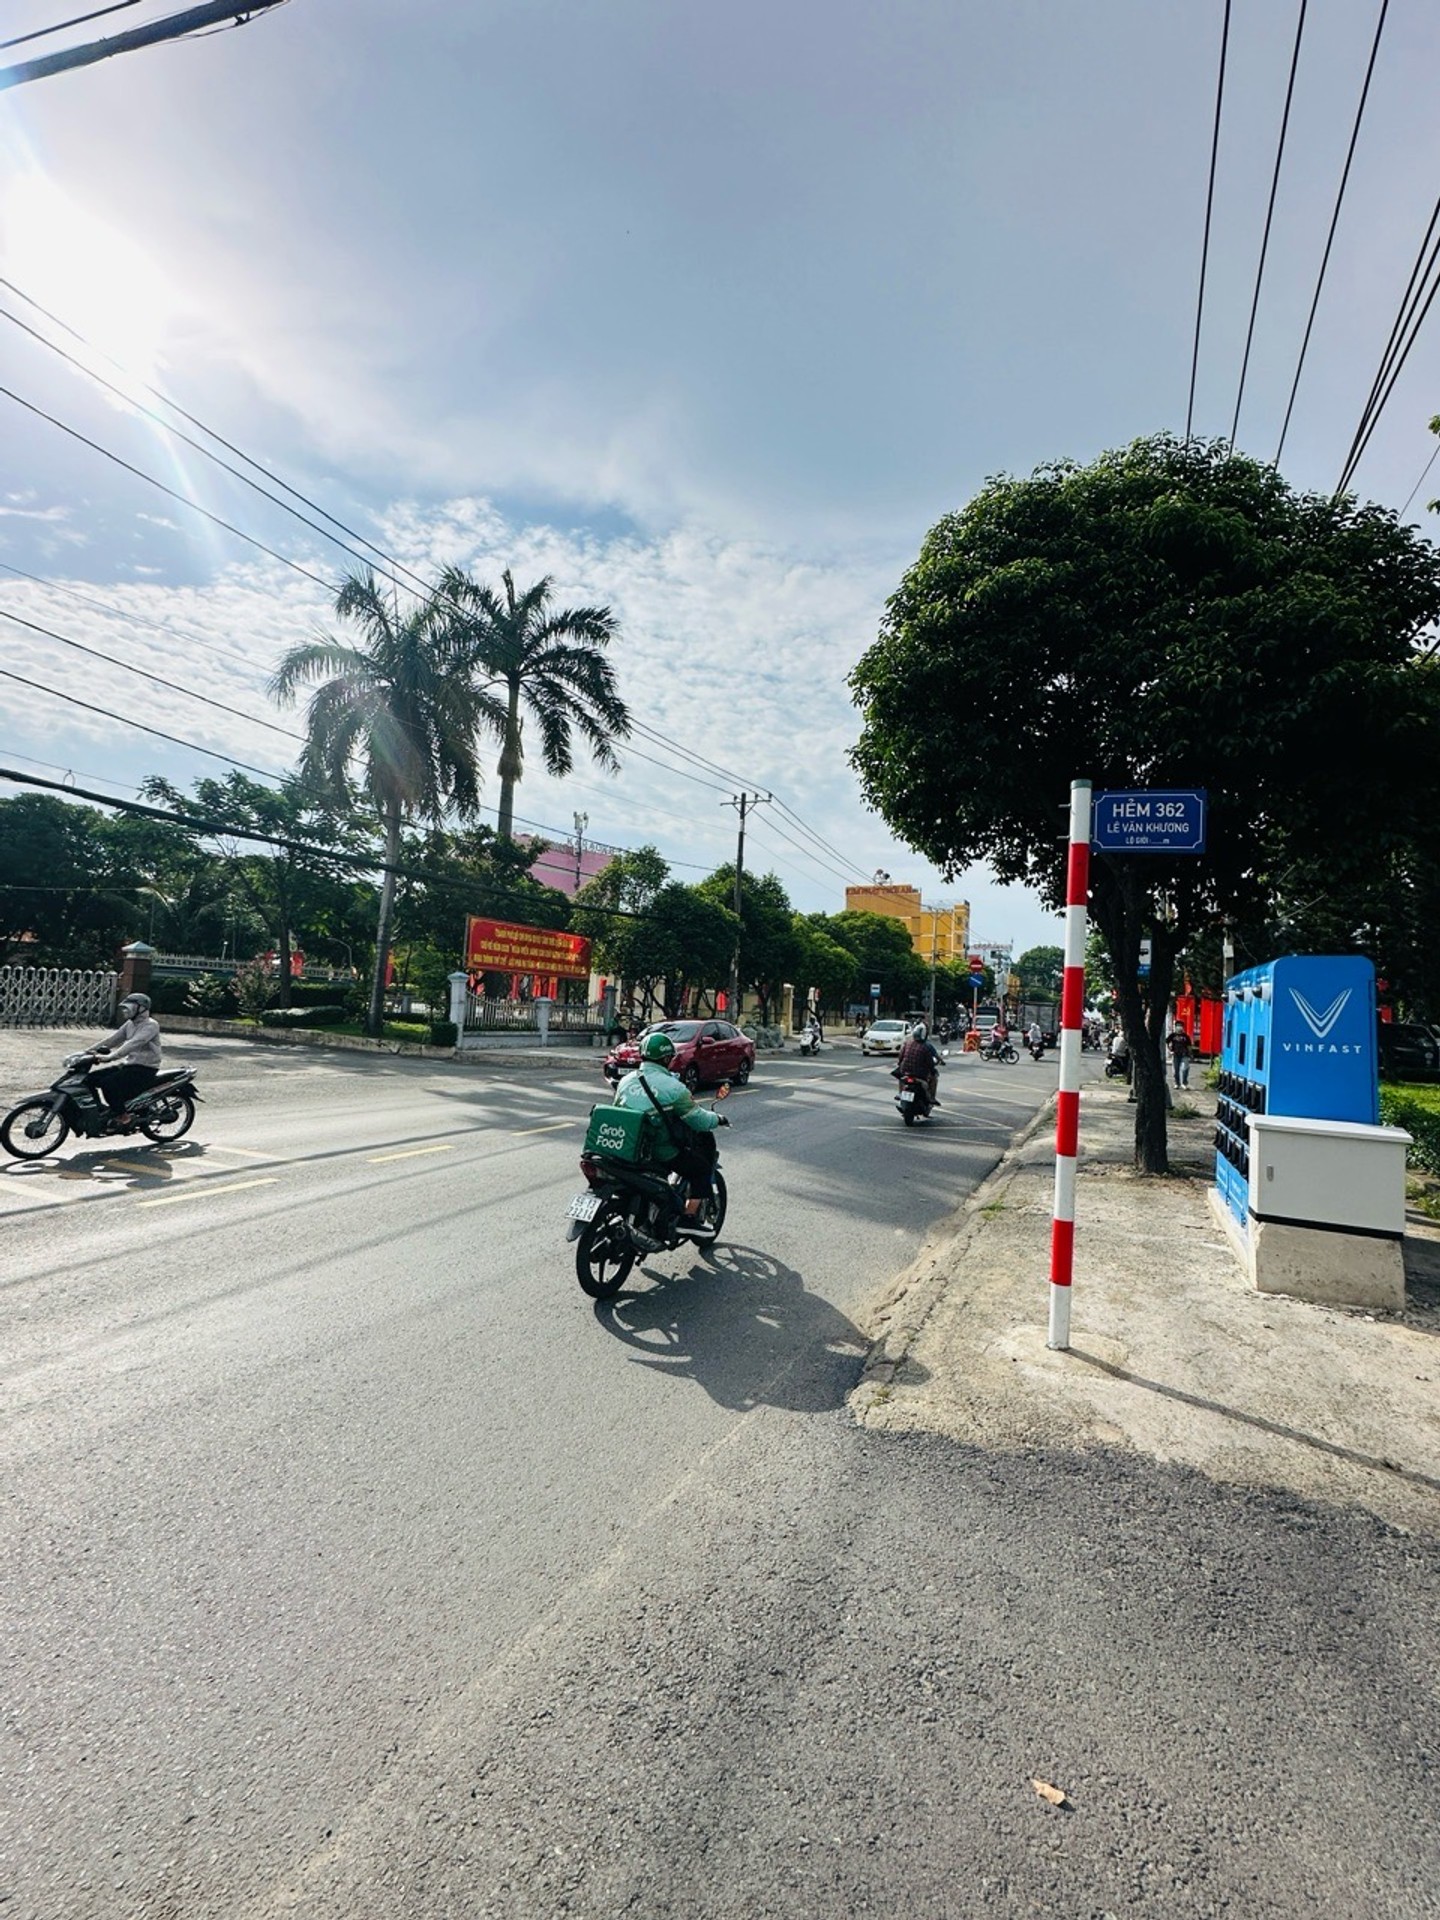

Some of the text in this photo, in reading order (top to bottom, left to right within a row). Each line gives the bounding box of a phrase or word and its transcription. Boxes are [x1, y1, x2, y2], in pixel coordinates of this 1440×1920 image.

[1113, 798, 1184, 817] HẺM 362
[1107, 820, 1190, 834] LÊ VĂN KHƯƠNG
[1282, 1043, 1361, 1054] VINFAST
[599, 1123, 626, 1138] Grab
